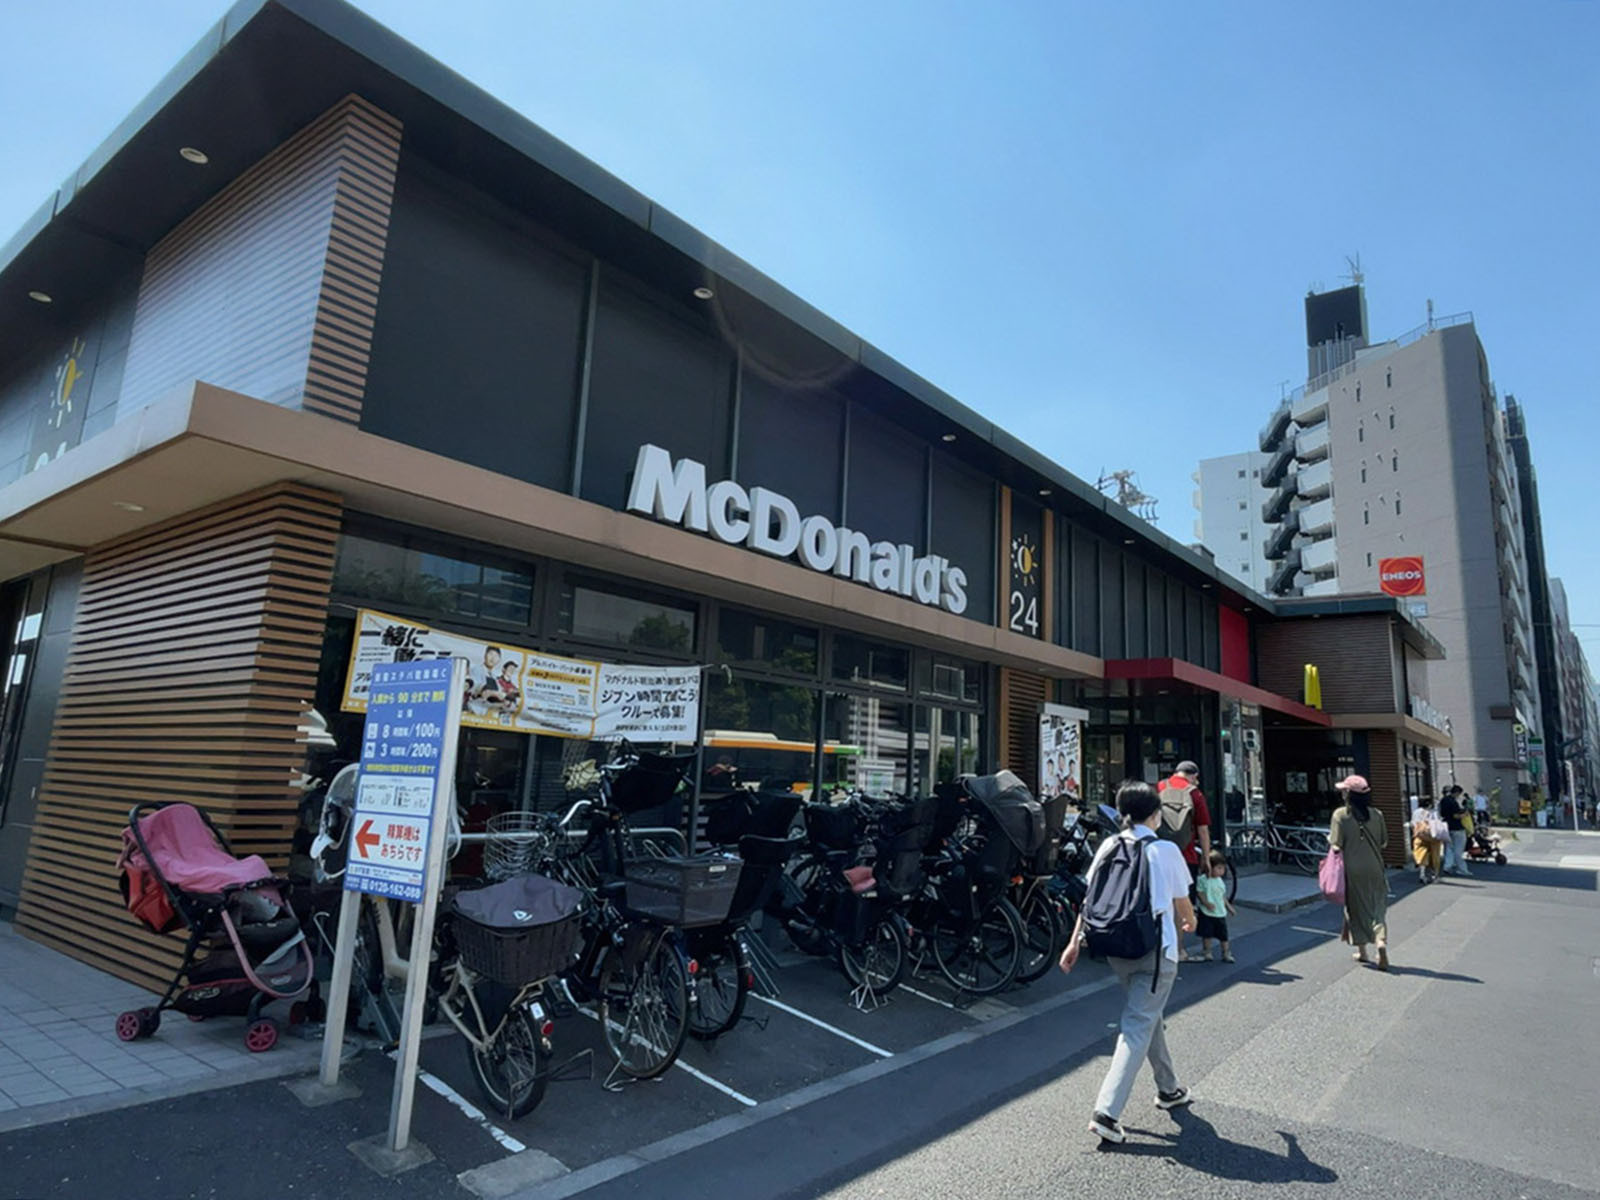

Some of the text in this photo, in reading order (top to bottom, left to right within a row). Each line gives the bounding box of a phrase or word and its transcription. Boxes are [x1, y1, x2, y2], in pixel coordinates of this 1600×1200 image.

[627, 443, 968, 615] McDonald's
[1382, 570, 1422, 581] ENEOS
[1010, 590, 1039, 636] 24
[382, 724, 391, 739] 8
[380, 743, 389, 758] 3
[380, 843, 422, 862] あちらです
